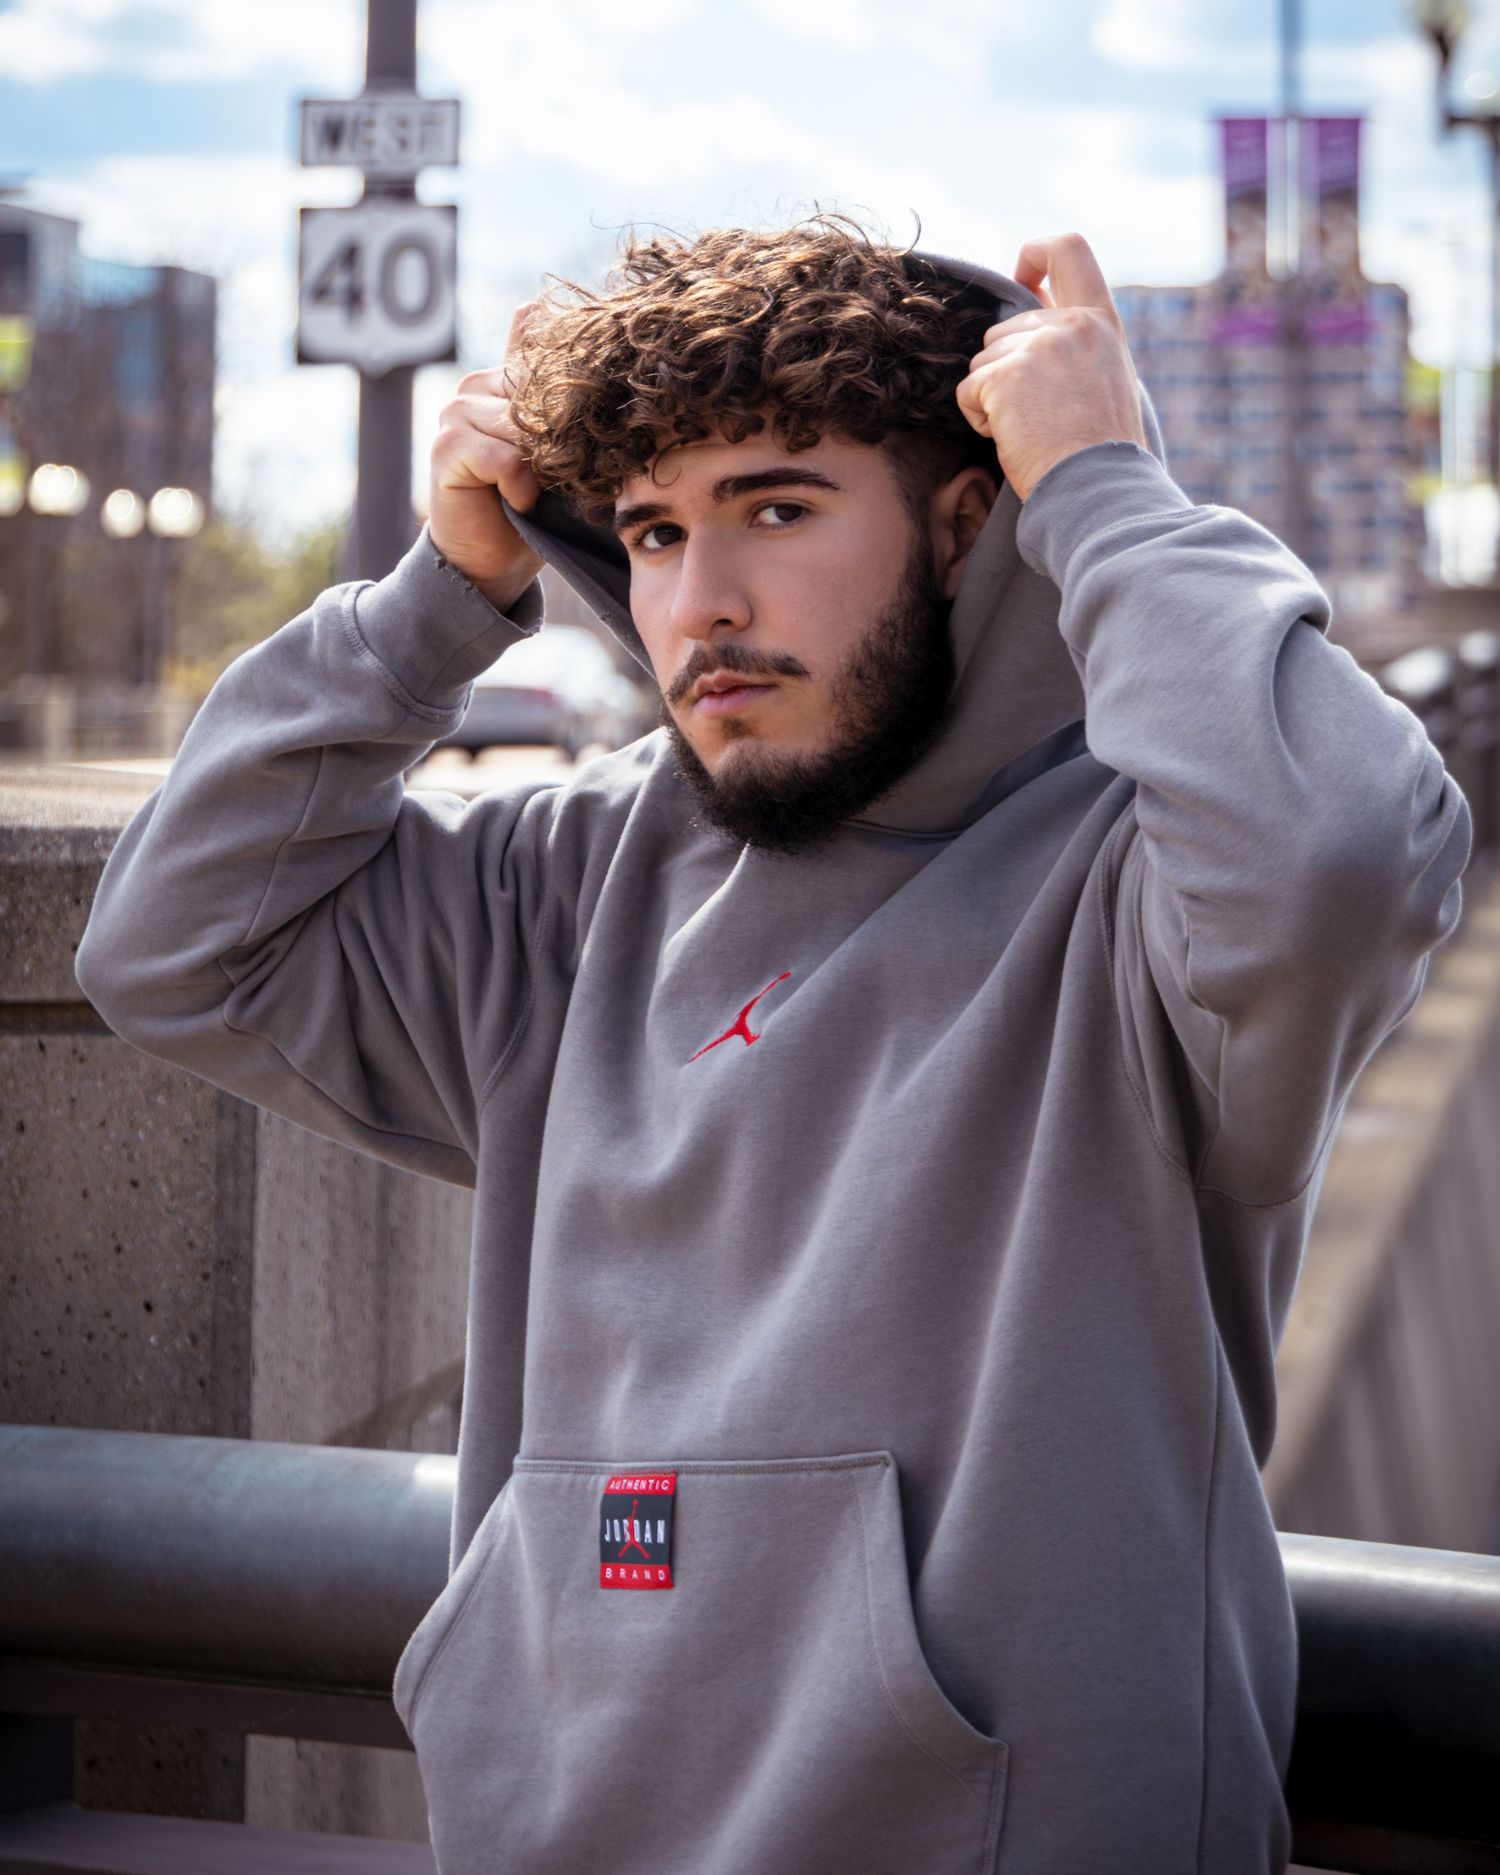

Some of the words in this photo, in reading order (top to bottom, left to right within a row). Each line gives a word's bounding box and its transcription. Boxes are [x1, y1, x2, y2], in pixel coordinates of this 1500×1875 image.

[313, 107, 447, 160] WEST
[309, 235, 443, 328] 40
[608, 1479, 670, 1491] AUTHENTIC
[604, 1518, 666, 1544] JORDAN
[604, 1567, 666, 1581] BRAND
